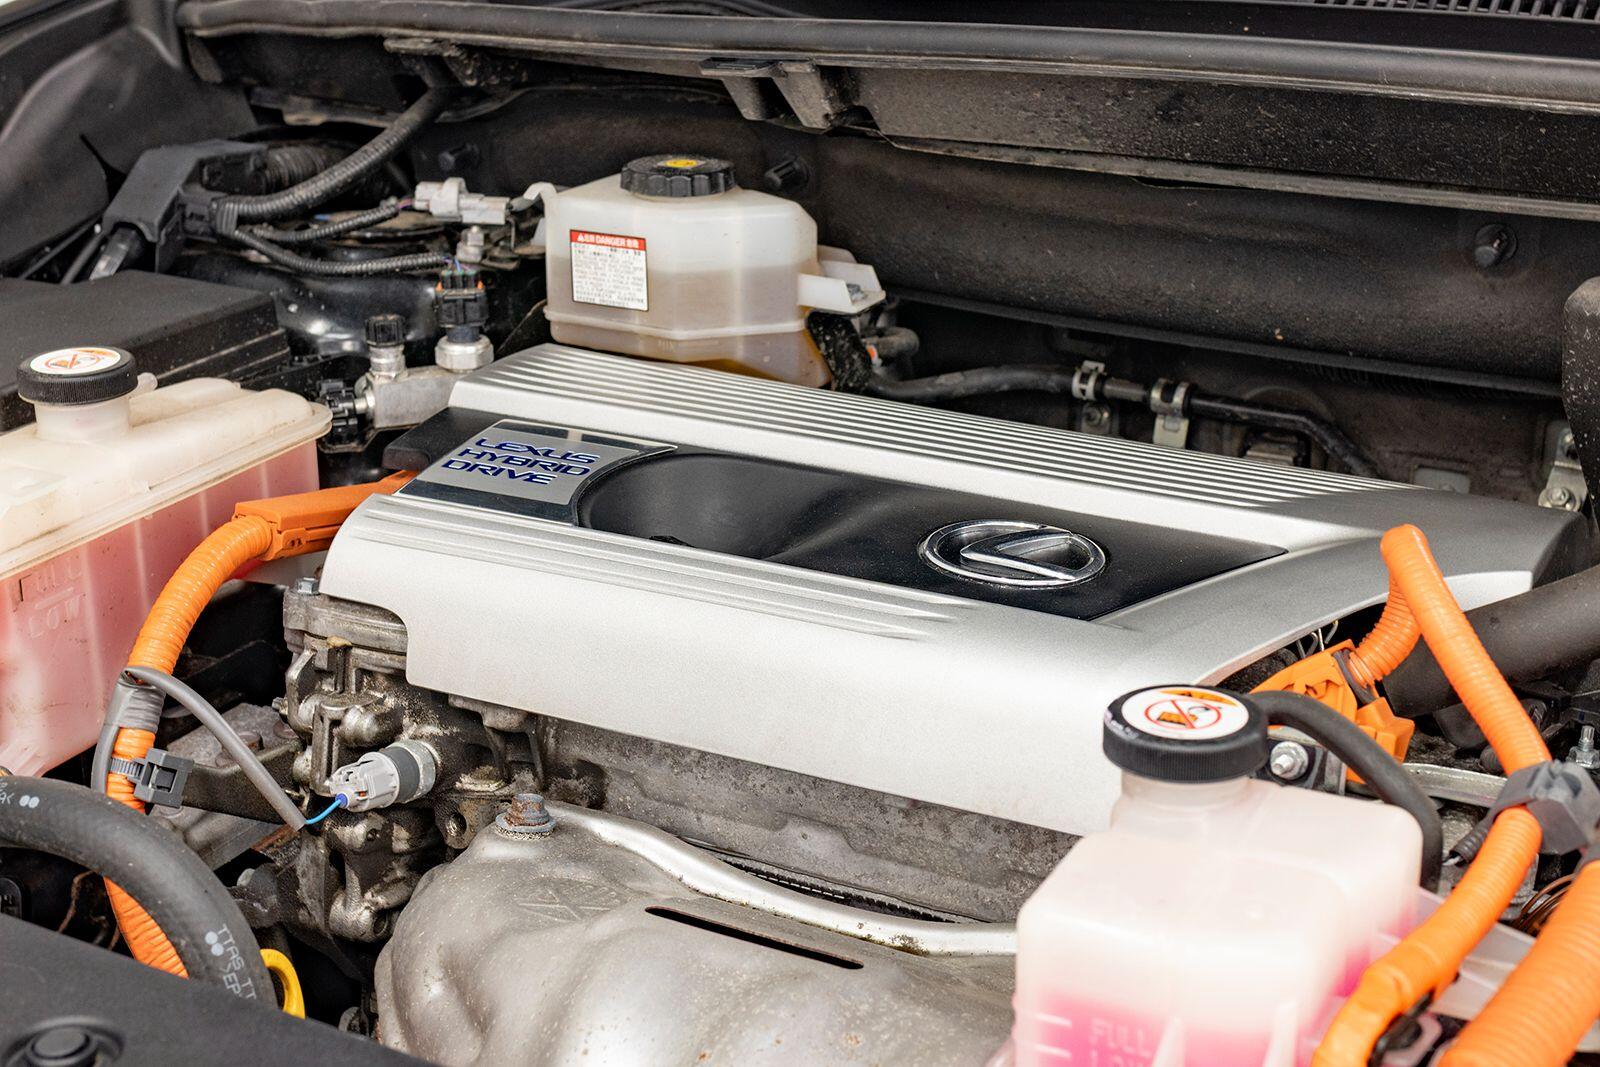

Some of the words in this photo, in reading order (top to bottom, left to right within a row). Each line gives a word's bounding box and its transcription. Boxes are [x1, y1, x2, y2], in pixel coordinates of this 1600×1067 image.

[457, 448, 592, 476] HYBRID
[475, 437, 601, 464] LEXUS
[441, 457, 559, 485] DRIVE
[1088, 1017, 1153, 1059] FULL
